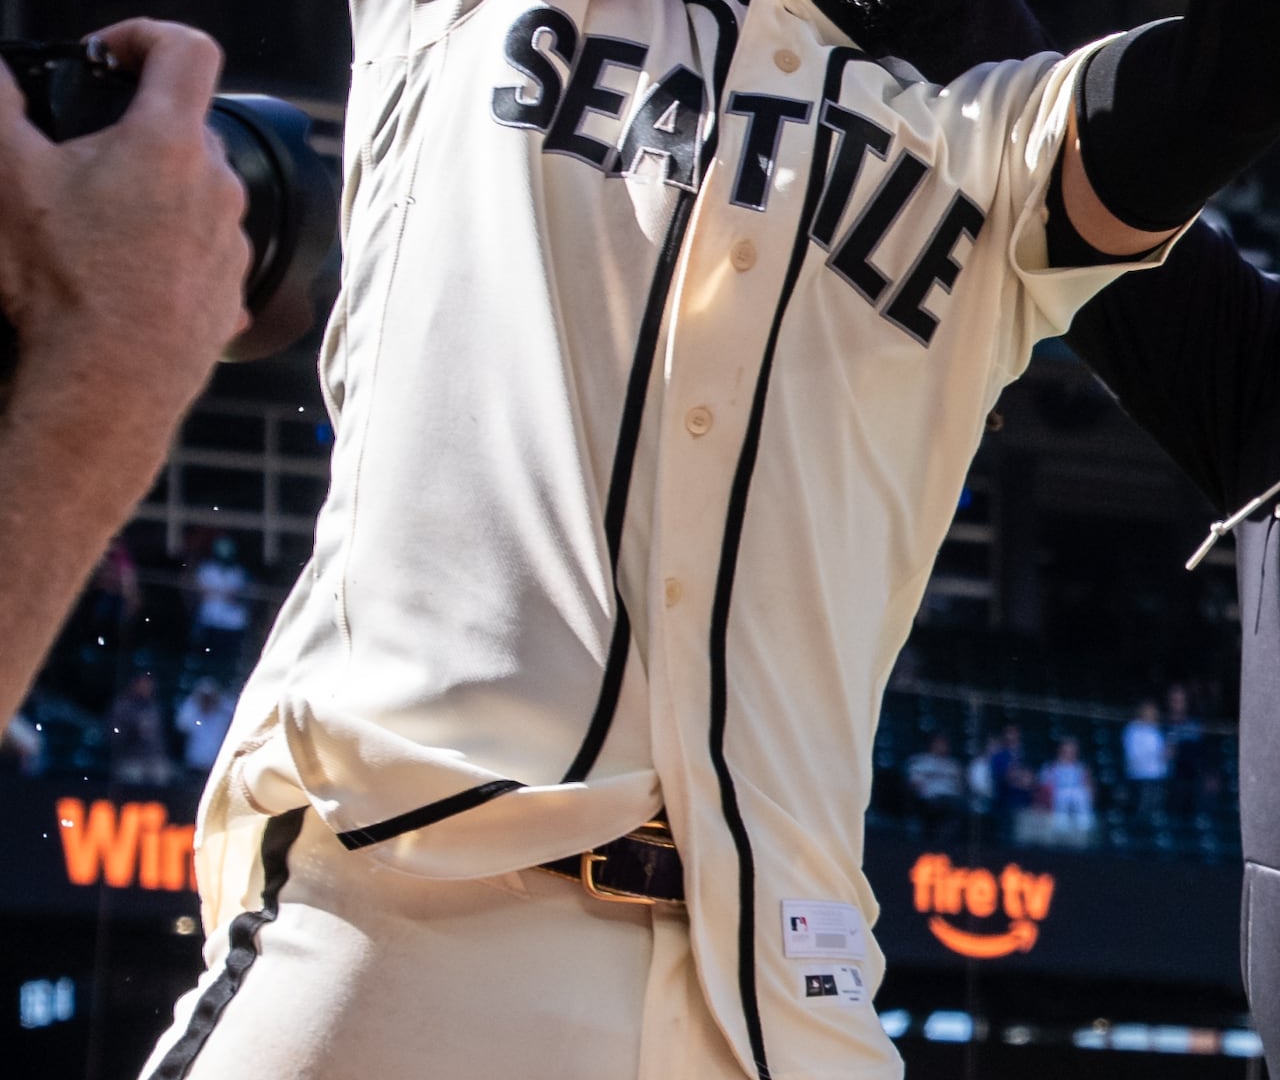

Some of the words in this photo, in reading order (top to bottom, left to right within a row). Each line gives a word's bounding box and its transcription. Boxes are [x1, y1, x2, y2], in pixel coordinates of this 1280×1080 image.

[491, 6, 988, 349] SEATTLE
[910, 853, 998, 918] fire
[1001, 863, 1056, 921] tv
